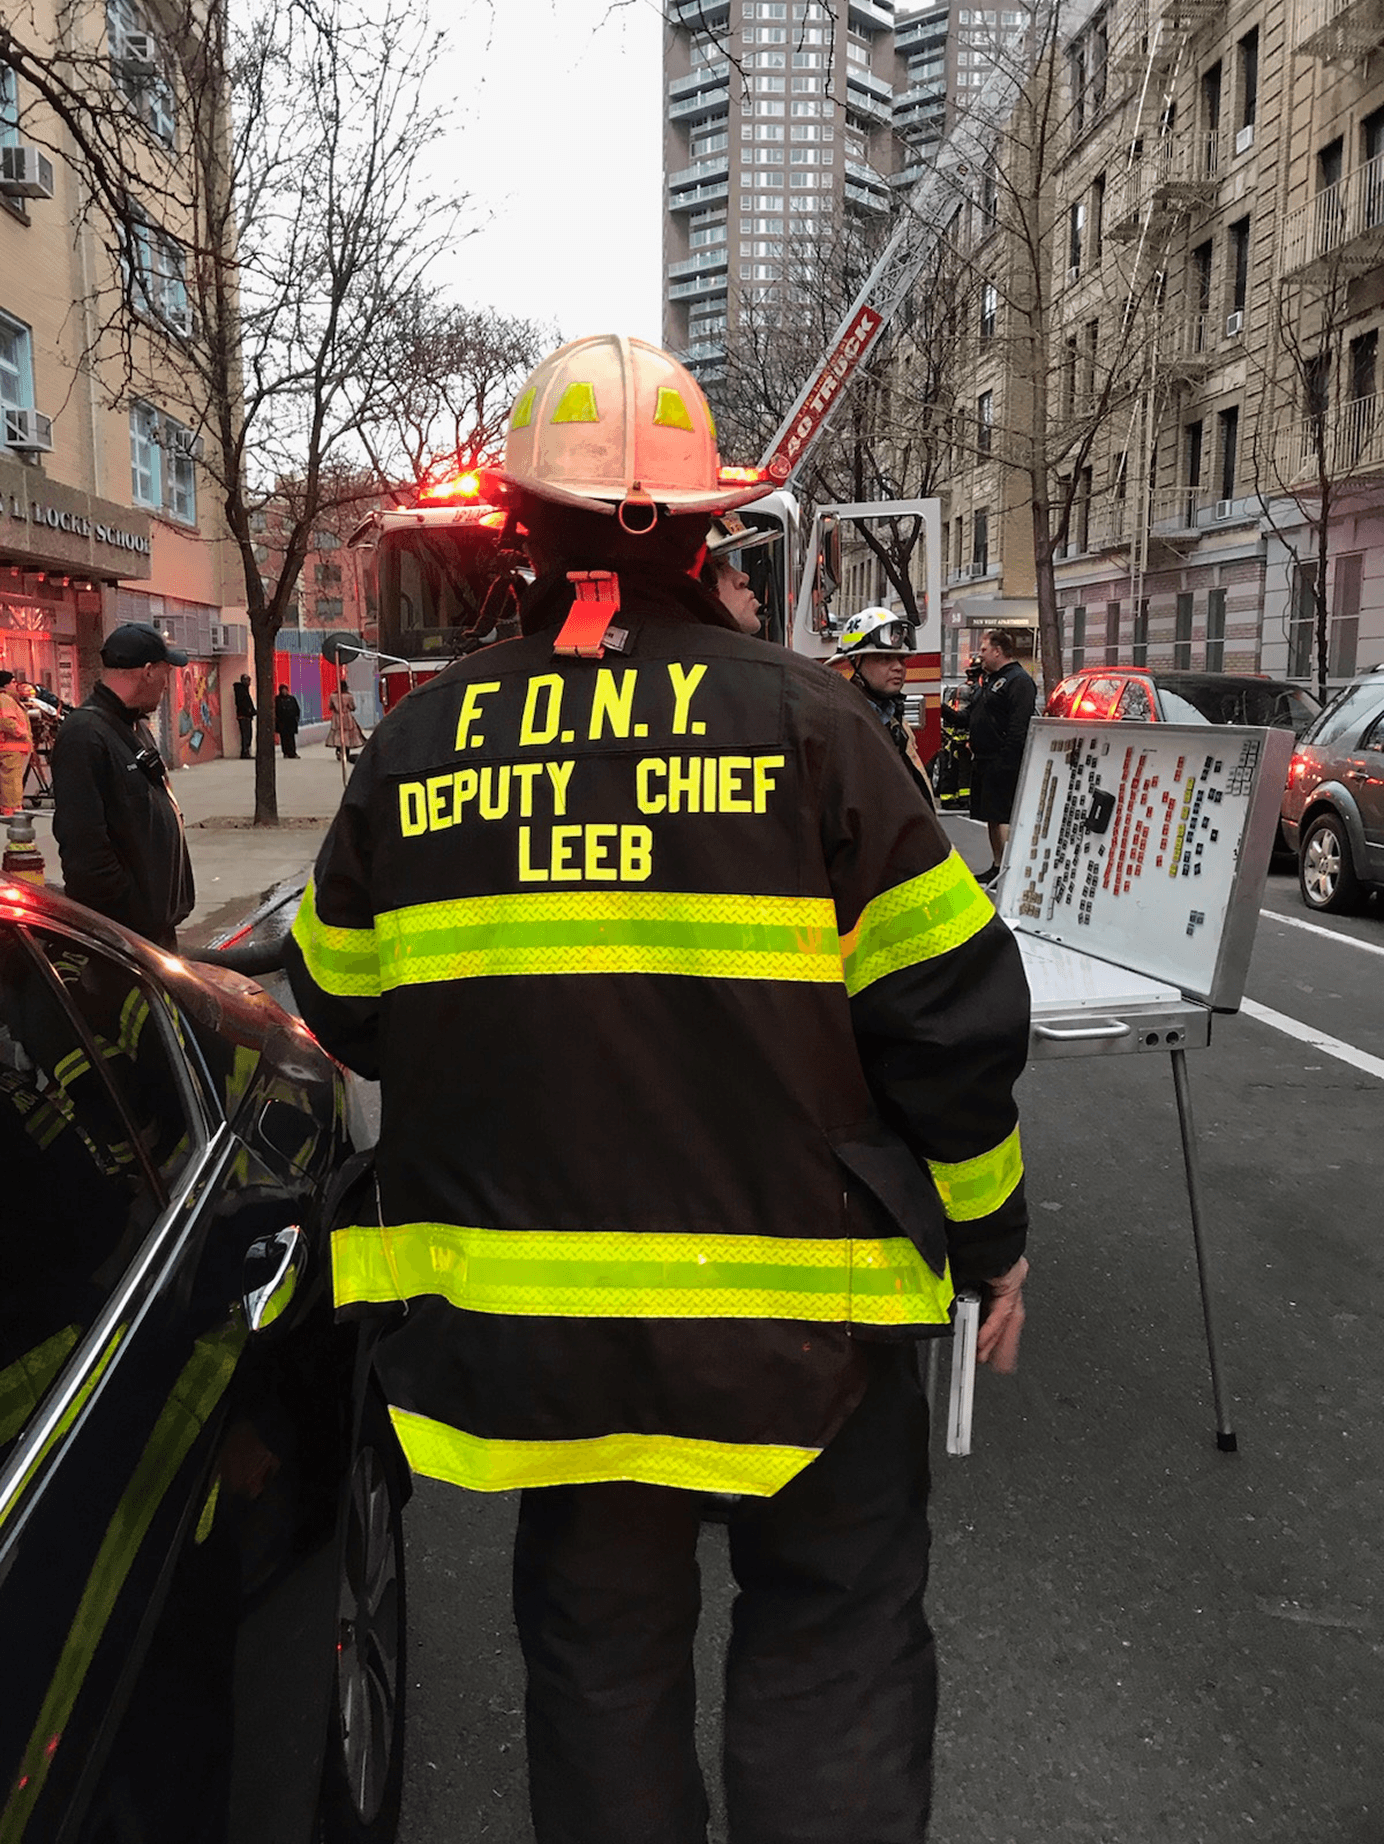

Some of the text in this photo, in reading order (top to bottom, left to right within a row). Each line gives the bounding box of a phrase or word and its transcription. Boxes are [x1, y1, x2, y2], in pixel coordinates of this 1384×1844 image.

[787, 416, 813, 457] 40
[810, 313, 875, 412] TRUCK
[33, 502, 91, 538] LOCKE
[96, 524, 150, 555] SCHOOL
[398, 755, 785, 838] DEPUTY CHIEF
[518, 823, 653, 882] LEEB
